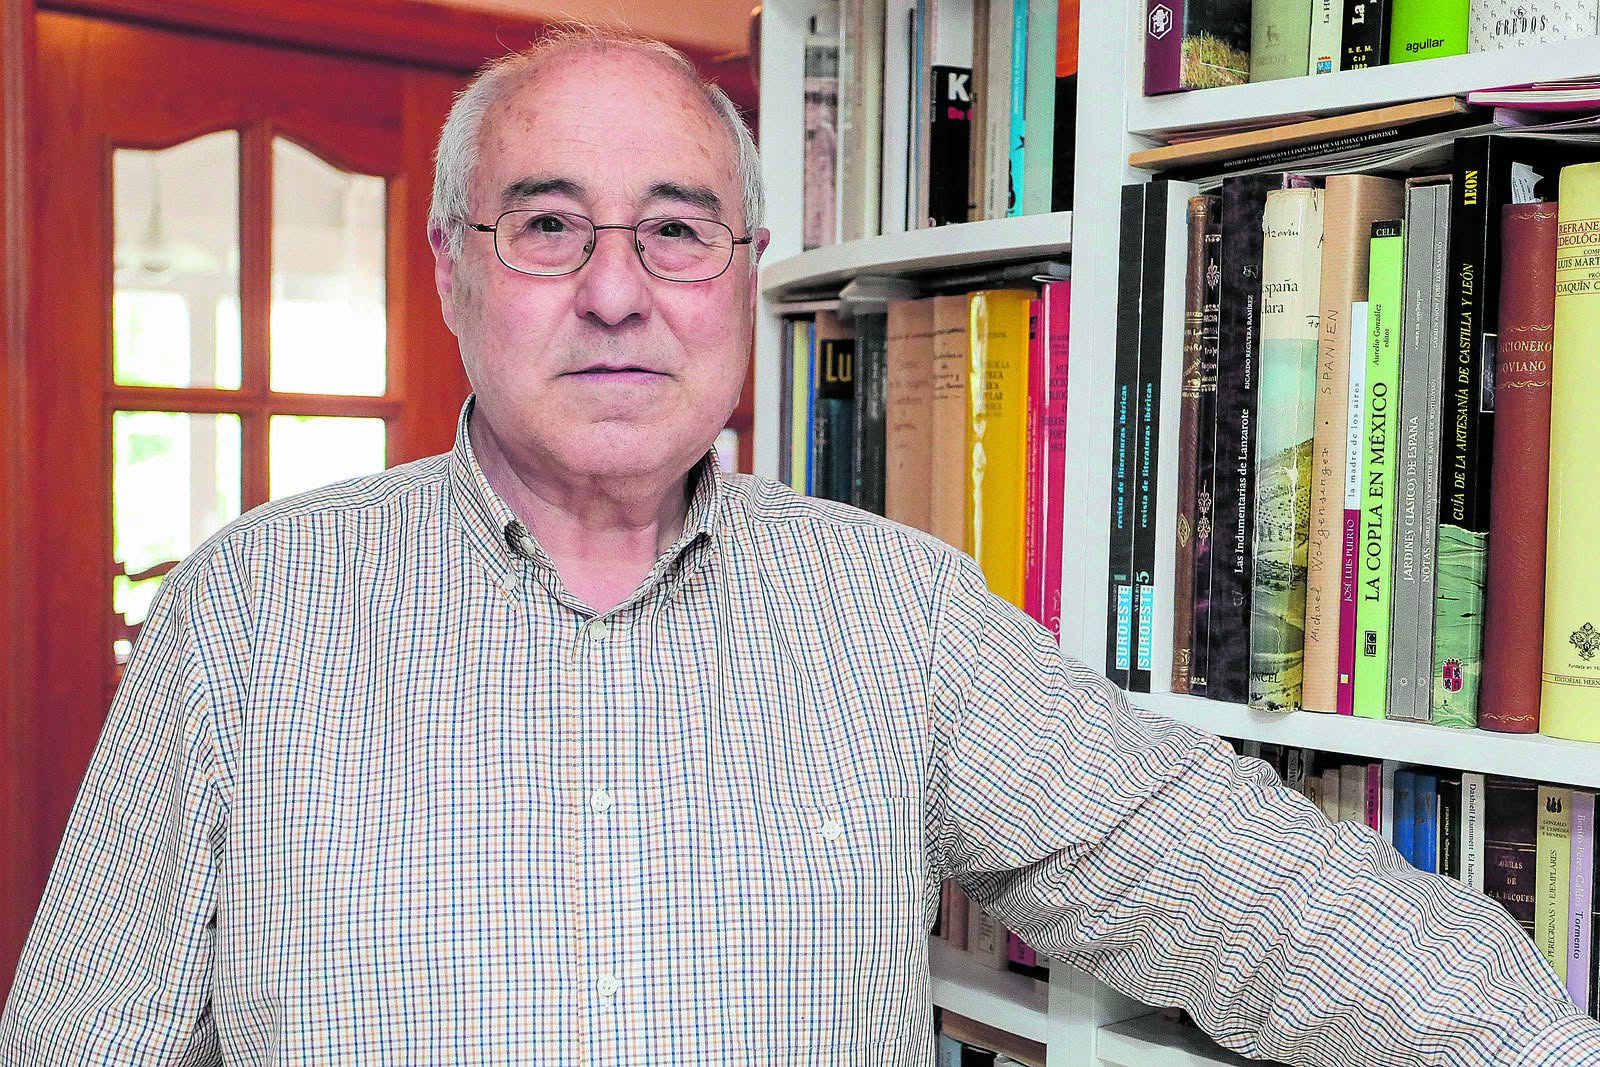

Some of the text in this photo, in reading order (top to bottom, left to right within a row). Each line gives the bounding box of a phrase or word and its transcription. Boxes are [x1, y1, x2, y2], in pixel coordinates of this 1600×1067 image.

[1351, 4, 1365, 25] La
[1495, 14, 1547, 36] GREDOS
[1406, 38, 1445, 53] aguilar
[1331, 136, 1363, 148] SALAMANCA
[1368, 129, 1399, 140] PROVINCIA
[1464, 170, 1478, 205] LEON
[1558, 221, 1600, 234] REFRANE
[1246, 295, 1254, 326] RAMÍREZ
[1262, 279, 1299, 298] spaña
[1262, 299, 1284, 314] lara
[1371, 303, 1382, 366] Aurelio González
[1382, 328, 1390, 348] editor
[1451, 263, 1473, 521] GUÍA DE LA ARTESANÍA DE CASTILLA Y LEÓN
[1115, 385, 1128, 528] revista de literaturas ibéricas
[1140, 382, 1153, 528] revista de literaturas ibéricas
[1348, 381, 1360, 498] la madre de los aires
[1233, 408, 1250, 574] Las Indumentarias de Lanzarote
[1309, 585, 1323, 643] Michael
[1320, 308, 1339, 396] SPANIEN
[1364, 382, 1388, 602] LA COPLA EN MÉXICO
[1402, 415, 1419, 583] JARDINES CLÁSICOS DE ESPAÑA
[1135, 571, 1150, 584] 5
[1343, 518, 1356, 603] JOSÉ LUIS PUERTO
[1422, 547, 1431, 583] NOTAS
[1116, 586, 1130, 668] SUROESTE
[1138, 586, 1152, 668] SUROESTE
[1549, 849, 1558, 900] EJEMPLARES
[1547, 908, 1556, 958] PEREGRINAS
[1573, 910, 1584, 960] Tormento
